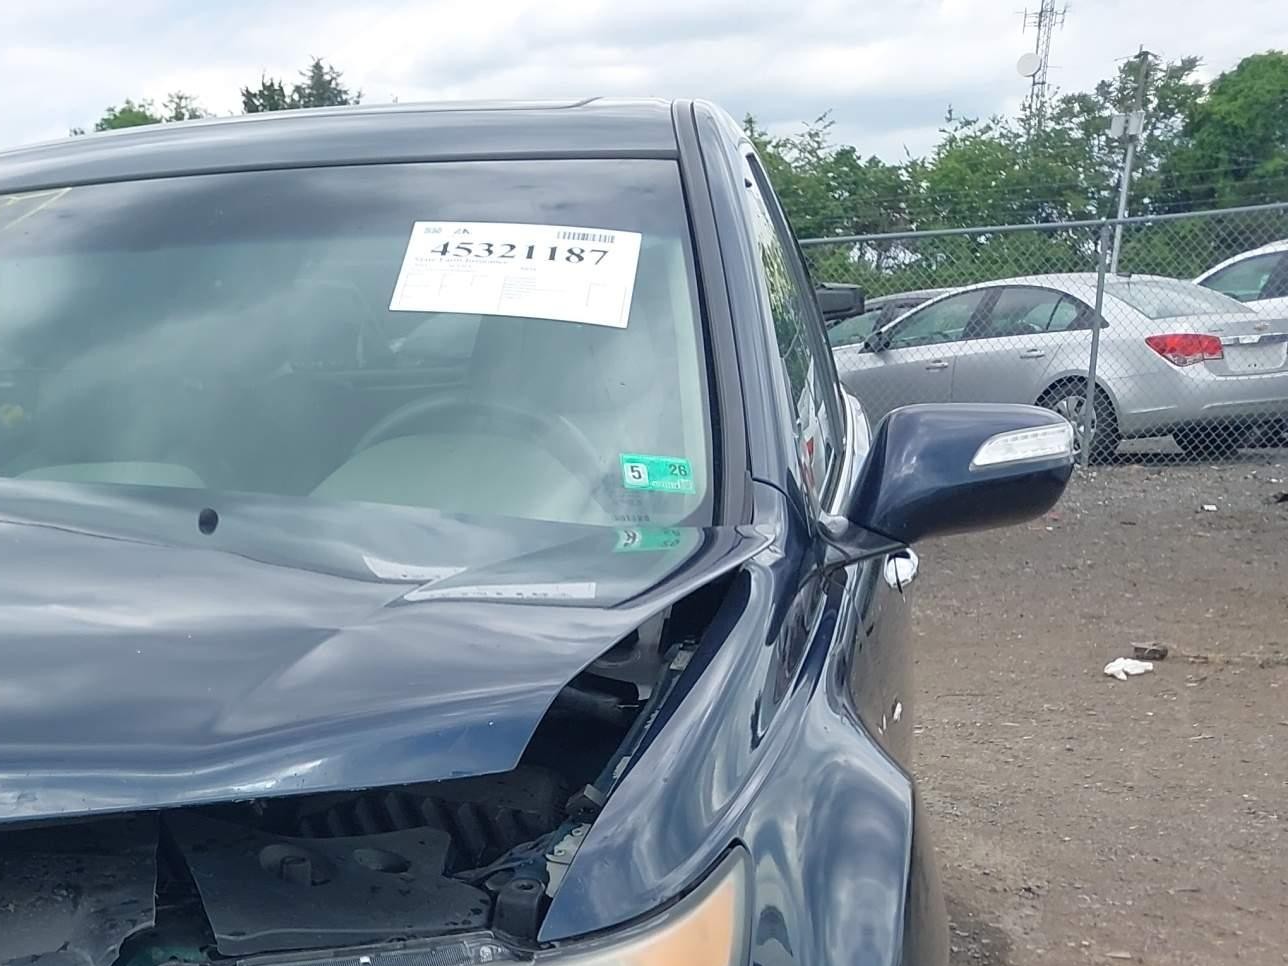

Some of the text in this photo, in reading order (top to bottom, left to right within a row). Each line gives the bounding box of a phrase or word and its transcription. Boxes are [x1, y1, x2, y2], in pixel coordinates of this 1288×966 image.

[430, 240, 609, 266] 45321187
[630, 463, 688, 480] 5 26
